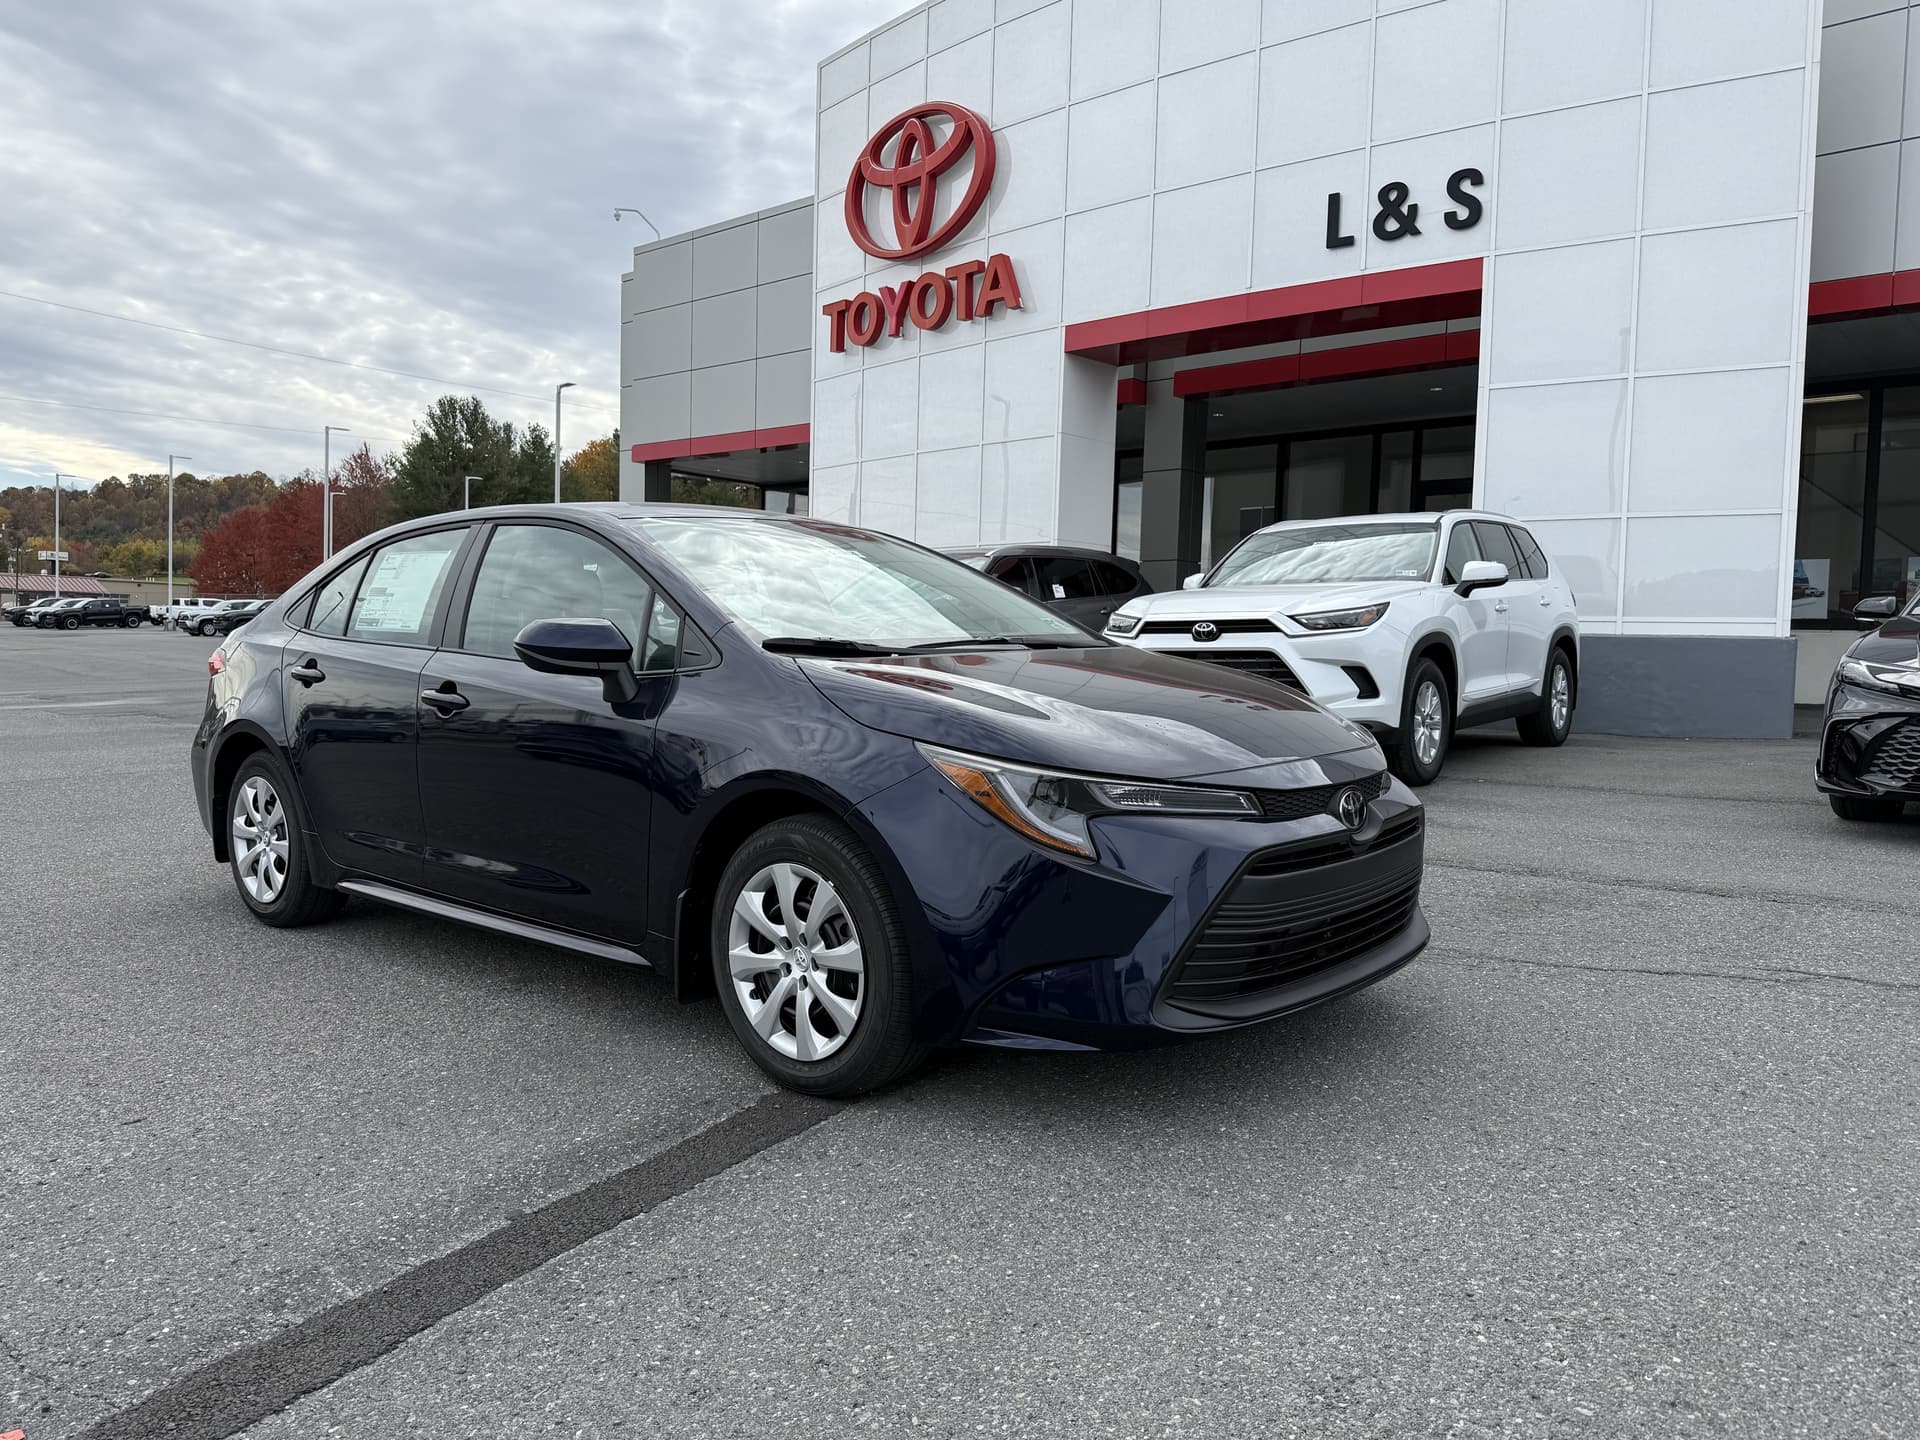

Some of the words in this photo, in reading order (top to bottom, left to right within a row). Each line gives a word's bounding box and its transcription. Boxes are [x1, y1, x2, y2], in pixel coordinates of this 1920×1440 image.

[1326, 192, 1354, 249] L
[1373, 181, 1421, 241] &
[1444, 168, 1483, 230] S
[823, 253, 1022, 353] TOYOTA
